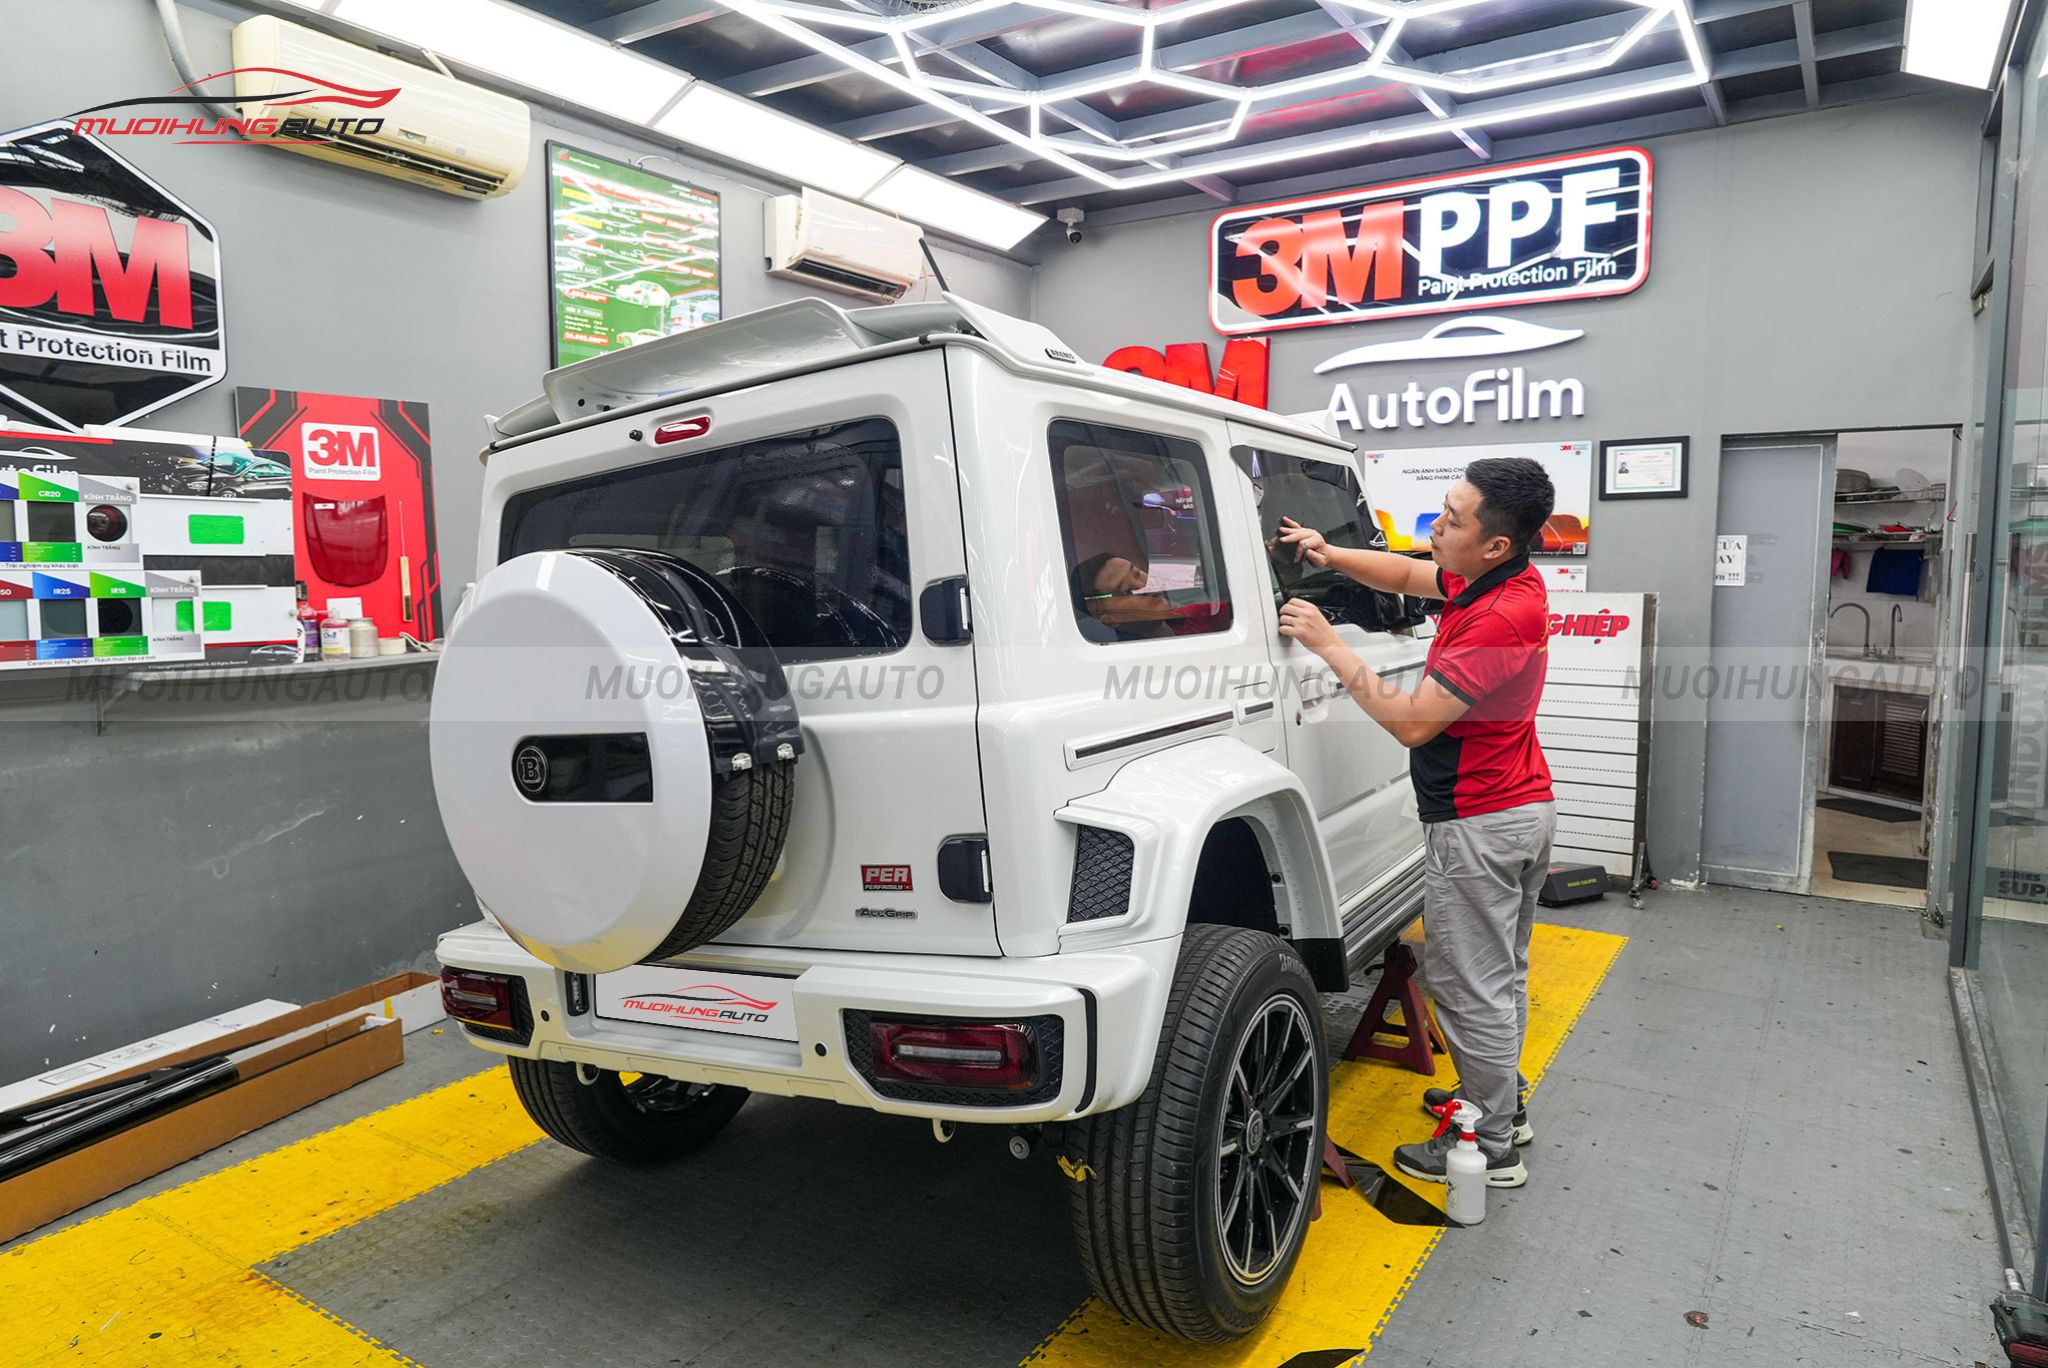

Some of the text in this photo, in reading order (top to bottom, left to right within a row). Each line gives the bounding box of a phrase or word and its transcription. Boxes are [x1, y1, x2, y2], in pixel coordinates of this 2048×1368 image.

[1233, 167, 1620, 316] 3M PPF
[1418, 258, 1618, 296] Paint Protection Film
[18, 329, 154, 366] Protection
[162, 347, 212, 372] Film
[1328, 366, 1586, 432] AutoFilm
[307, 428, 377, 468] 3M
[308, 467, 378, 477] Paint Protection Film
[111, 587, 127, 595] IR15
[1547, 608, 1630, 645] GHIỆP
[1998, 880, 2048, 898] SUP
